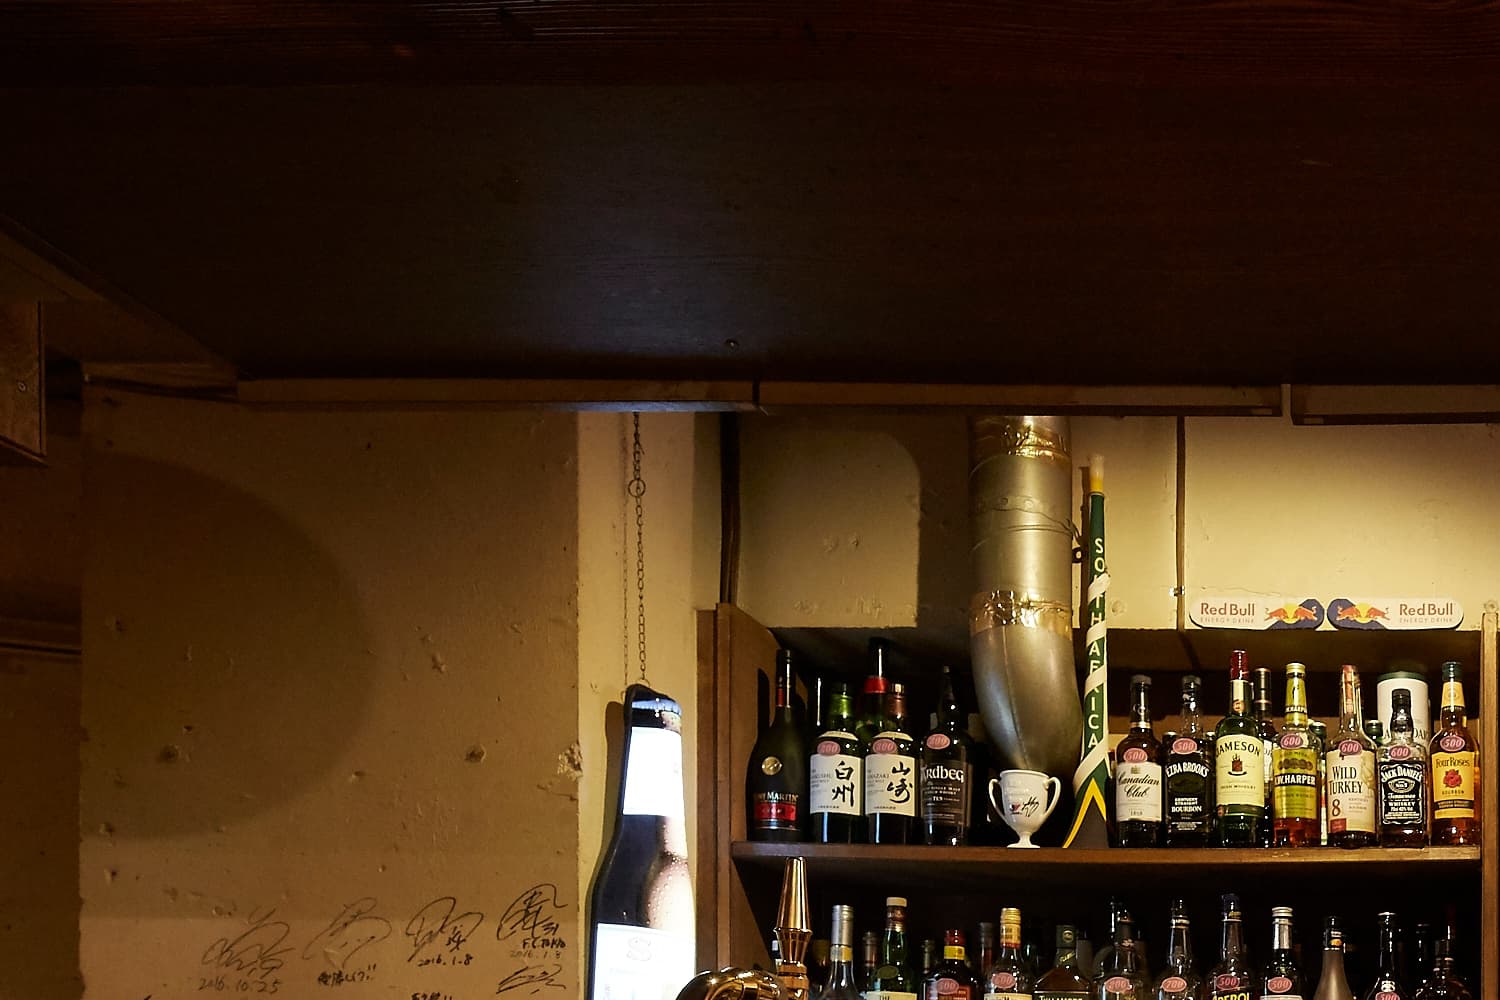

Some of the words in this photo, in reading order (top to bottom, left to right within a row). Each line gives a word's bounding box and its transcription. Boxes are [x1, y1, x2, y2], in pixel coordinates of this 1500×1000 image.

[1200, 602, 1227, 617] Red
[1230, 602, 1255, 617] Bull
[1400, 602, 1425, 617] Red
[1428, 602, 1453, 617] Bull
[1283, 736, 1301, 746] 600
[1341, 743, 1359, 753] 600
[1444, 738, 1462, 748] 500
[1216, 741, 1260, 757] JAMESON
[1391, 748, 1409, 758] 600
[1182, 761, 1209, 778] BROOKS
[1332, 765, 1357, 780] WILD
[1381, 769, 1398, 783] JACK
[832, 760, 855, 807] 白州
[1118, 773, 1160, 786] Canadian
[1124, 786, 1150, 798] Club
[1329, 781, 1363, 795] TURKEY
[1332, 799, 1341, 817] 8
[1219, 976, 1236, 987] 500
